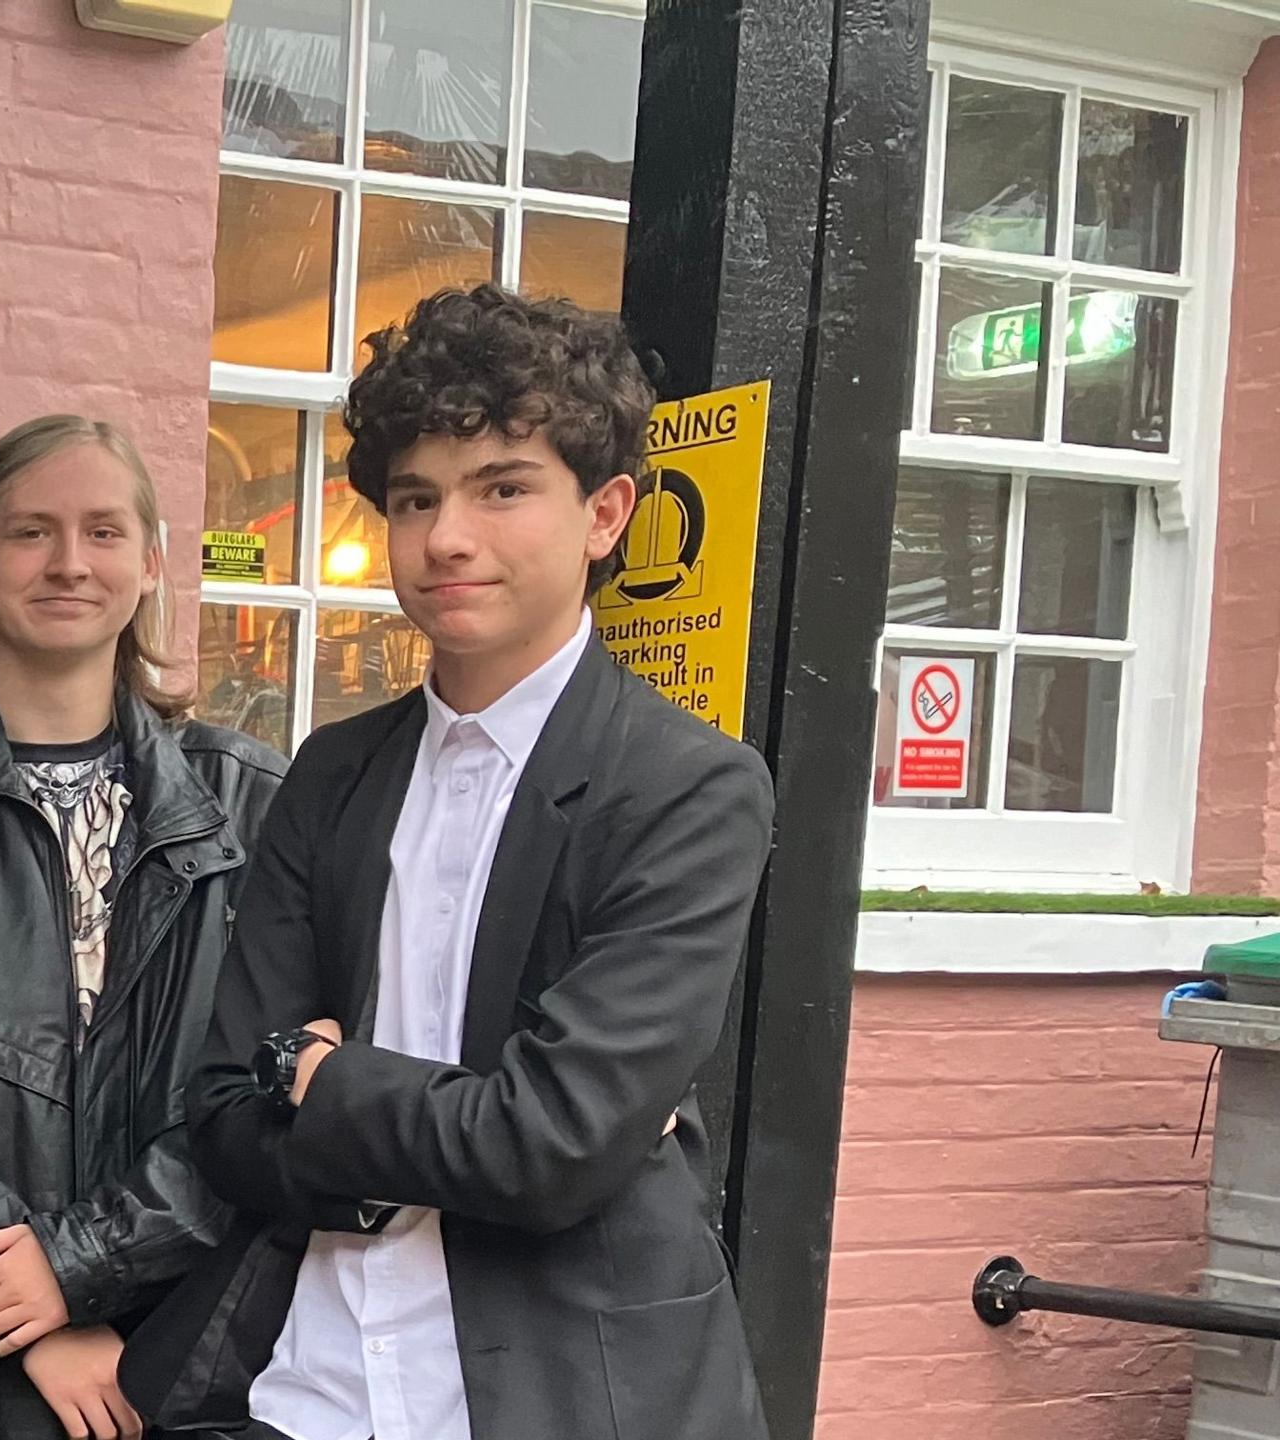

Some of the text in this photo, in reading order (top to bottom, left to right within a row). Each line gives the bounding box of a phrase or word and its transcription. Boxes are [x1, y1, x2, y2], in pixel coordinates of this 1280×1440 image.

[646, 403, 737, 448] RNING
[211, 532, 256, 545] BURGLARS
[210, 547, 256, 561] BEWARE
[597, 606, 722, 642] nauthorised
[637, 663, 714, 688] sult in
[672, 689, 709, 711] icle
[903, 746, 918, 758] NO
